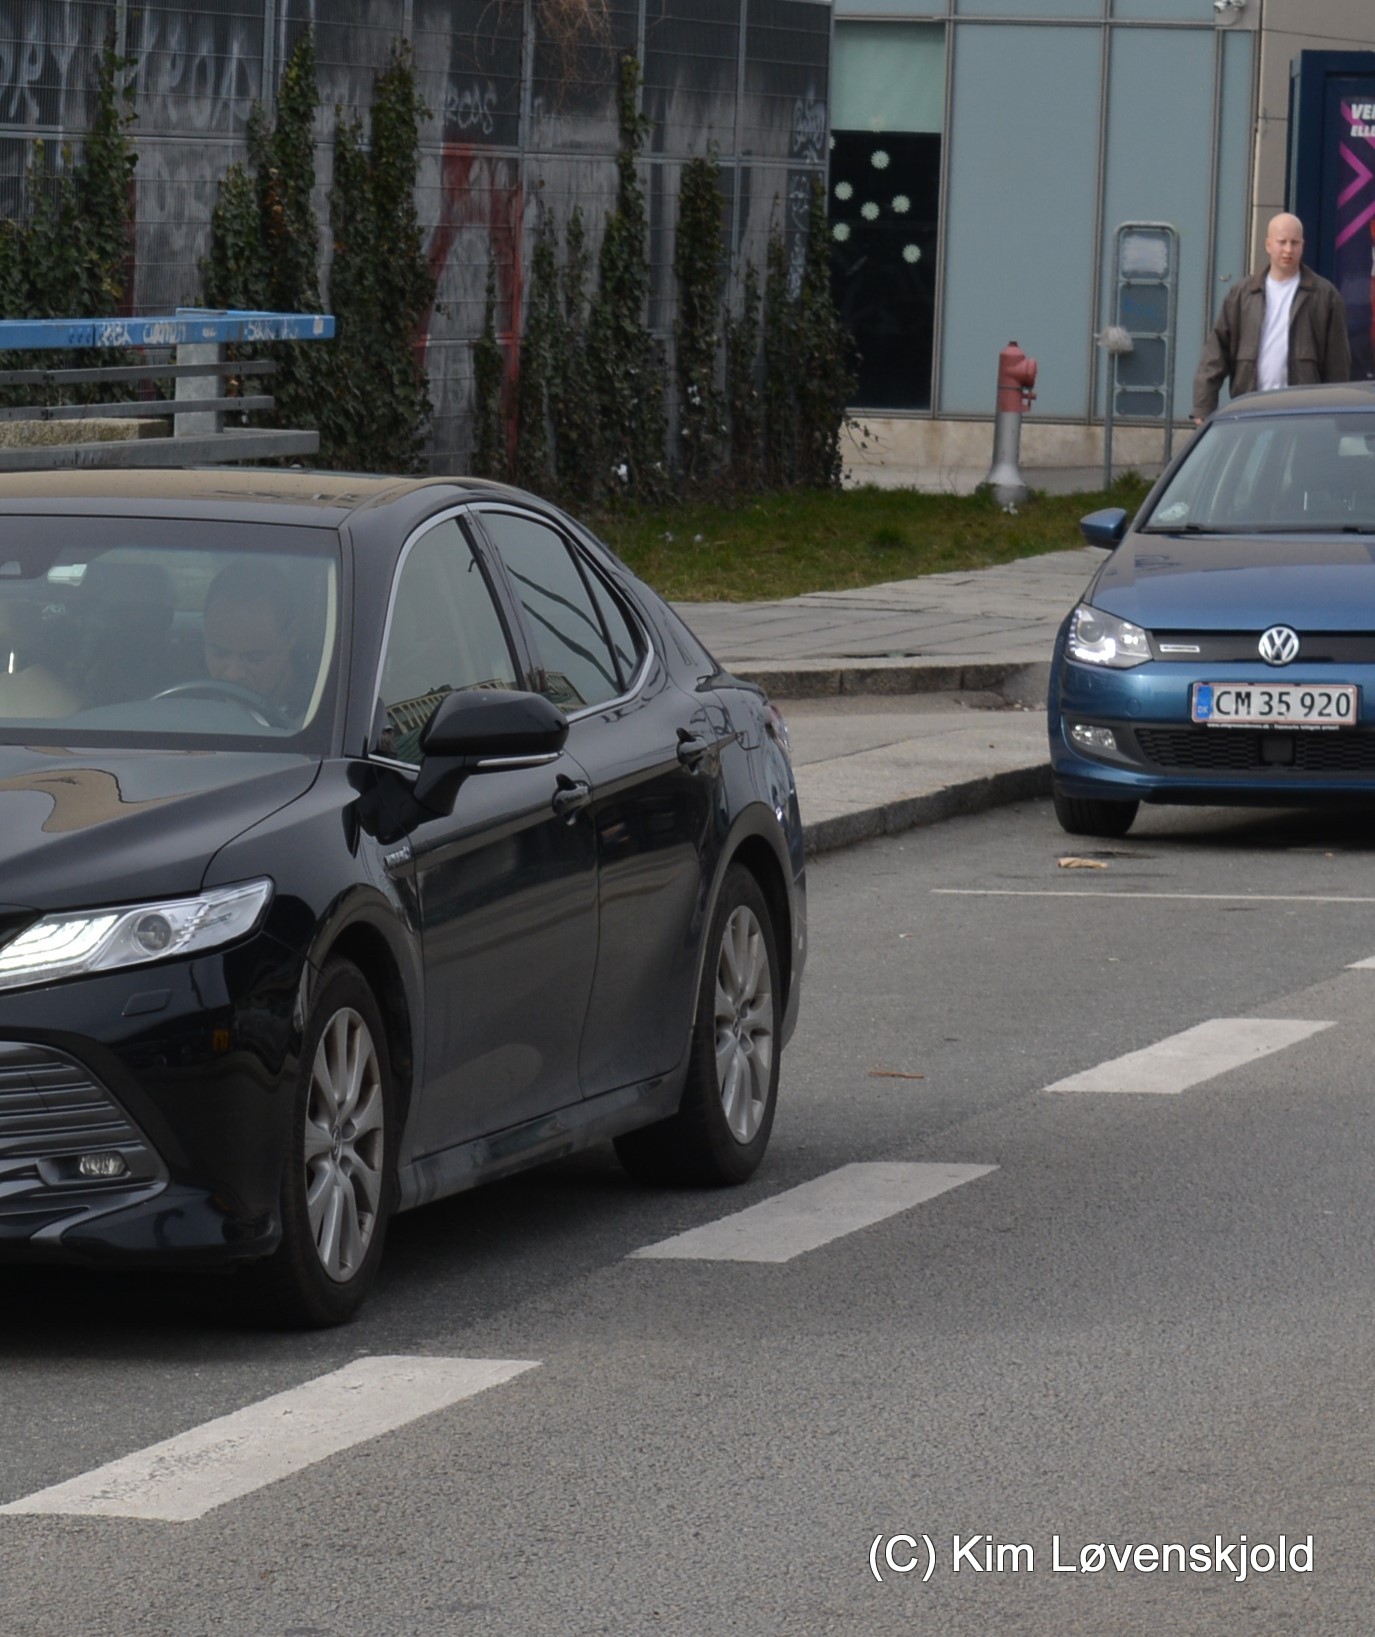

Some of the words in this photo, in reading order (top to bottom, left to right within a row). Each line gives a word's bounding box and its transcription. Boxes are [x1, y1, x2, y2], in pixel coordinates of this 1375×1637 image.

[1215, 690, 1252, 716] CM
[1258, 691, 1291, 716] 35
[1300, 692, 1351, 718] 920
